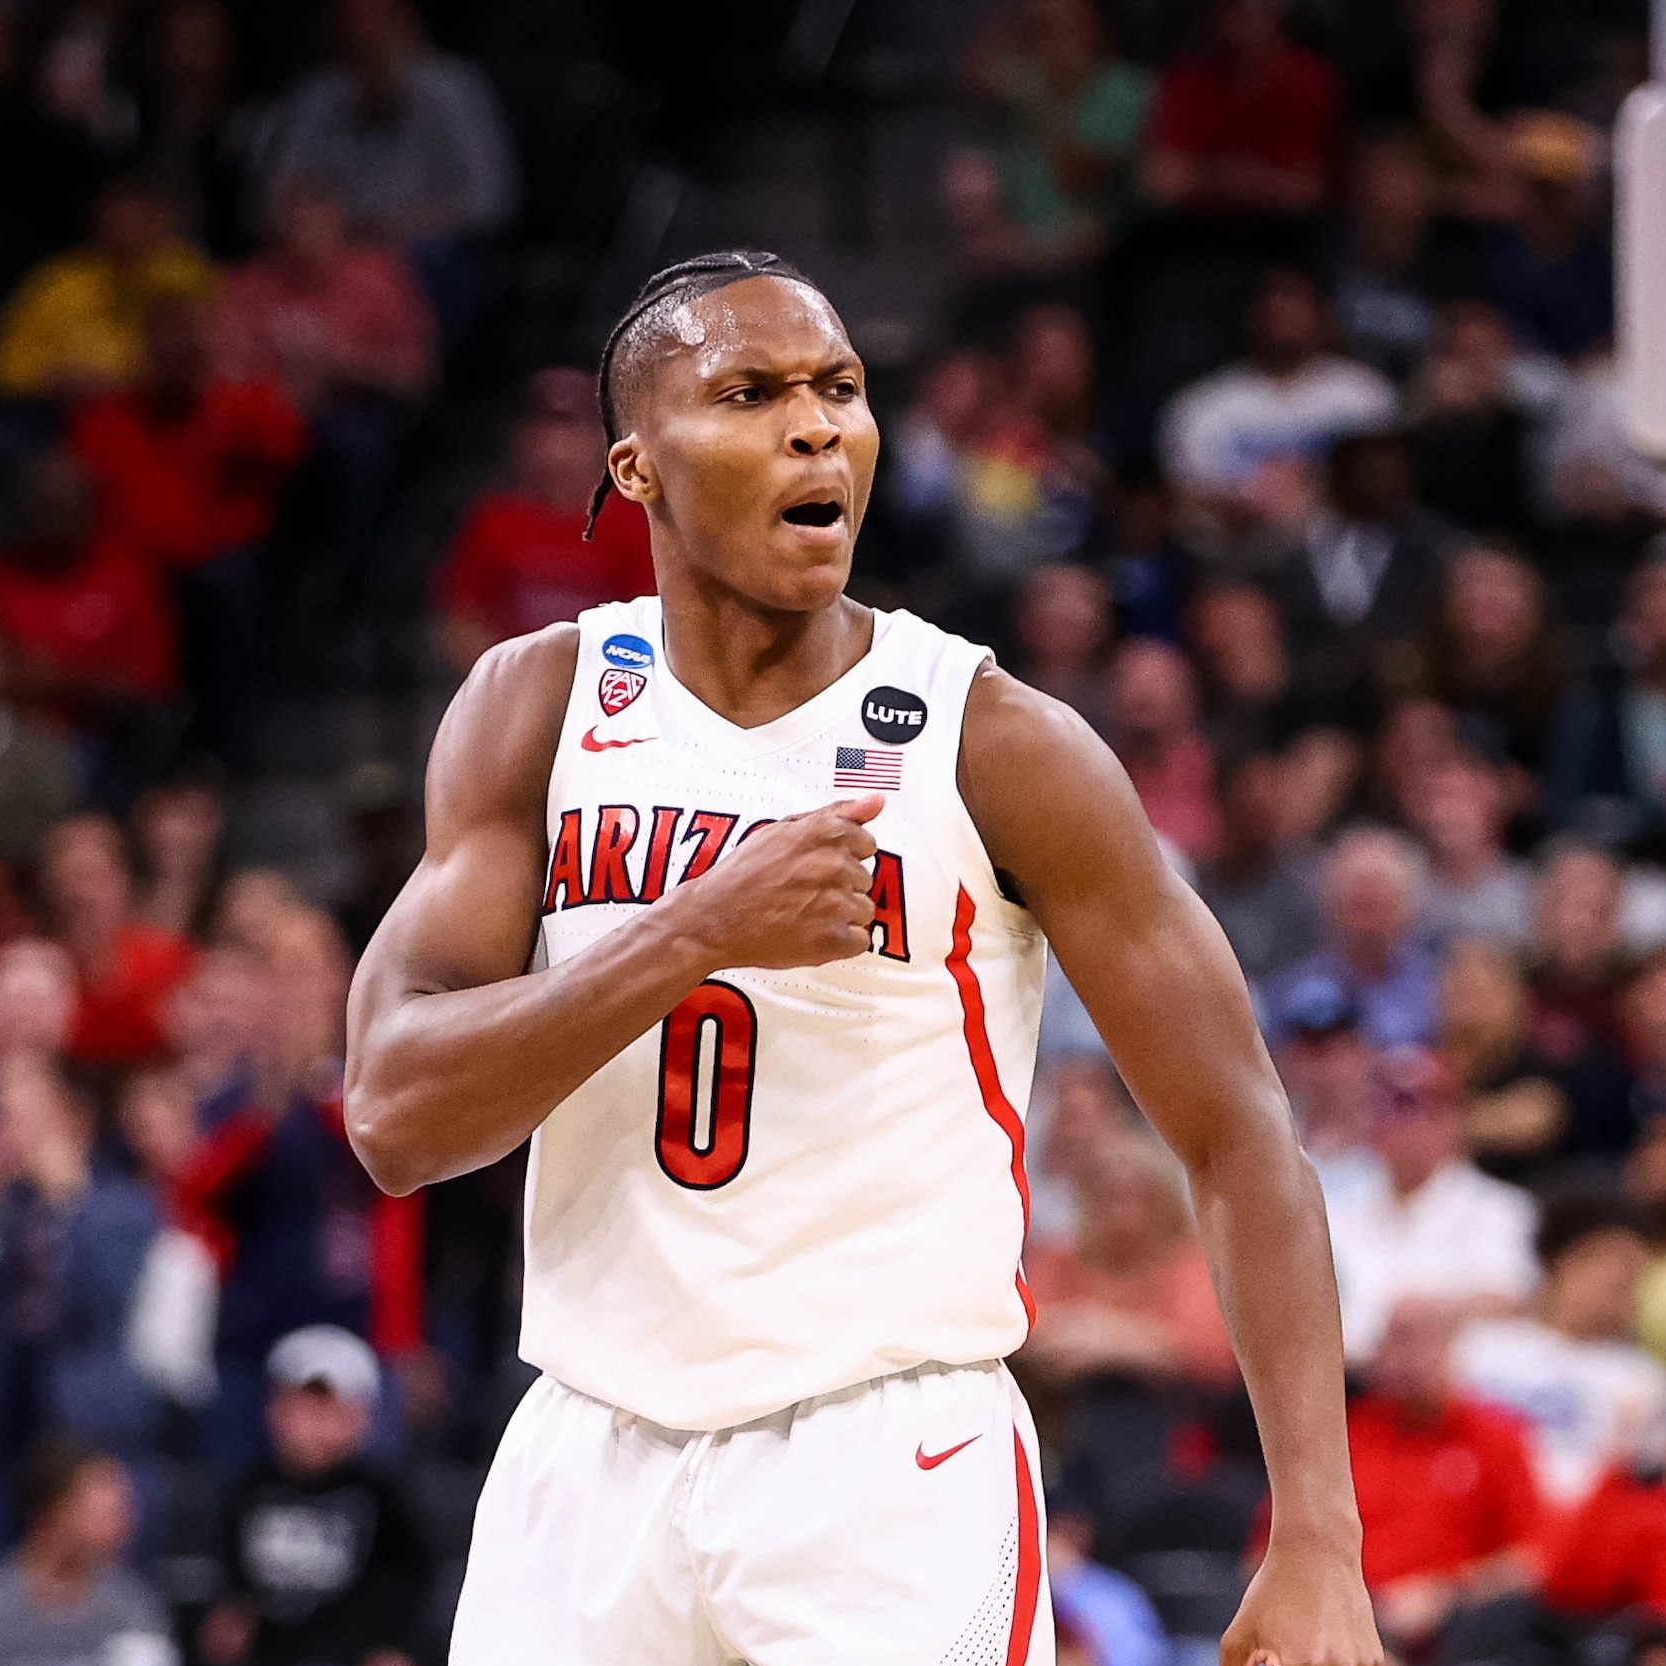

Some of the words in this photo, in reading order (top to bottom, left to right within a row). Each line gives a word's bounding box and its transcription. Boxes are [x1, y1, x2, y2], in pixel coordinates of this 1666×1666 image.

[605, 644, 652, 664] NCAA
[601, 670, 645, 701] PAC
[603, 687, 626, 708] 12
[866, 701, 923, 725] LUTE
[542, 804, 910, 962] ARIZA
[655, 979, 758, 1191] 0
